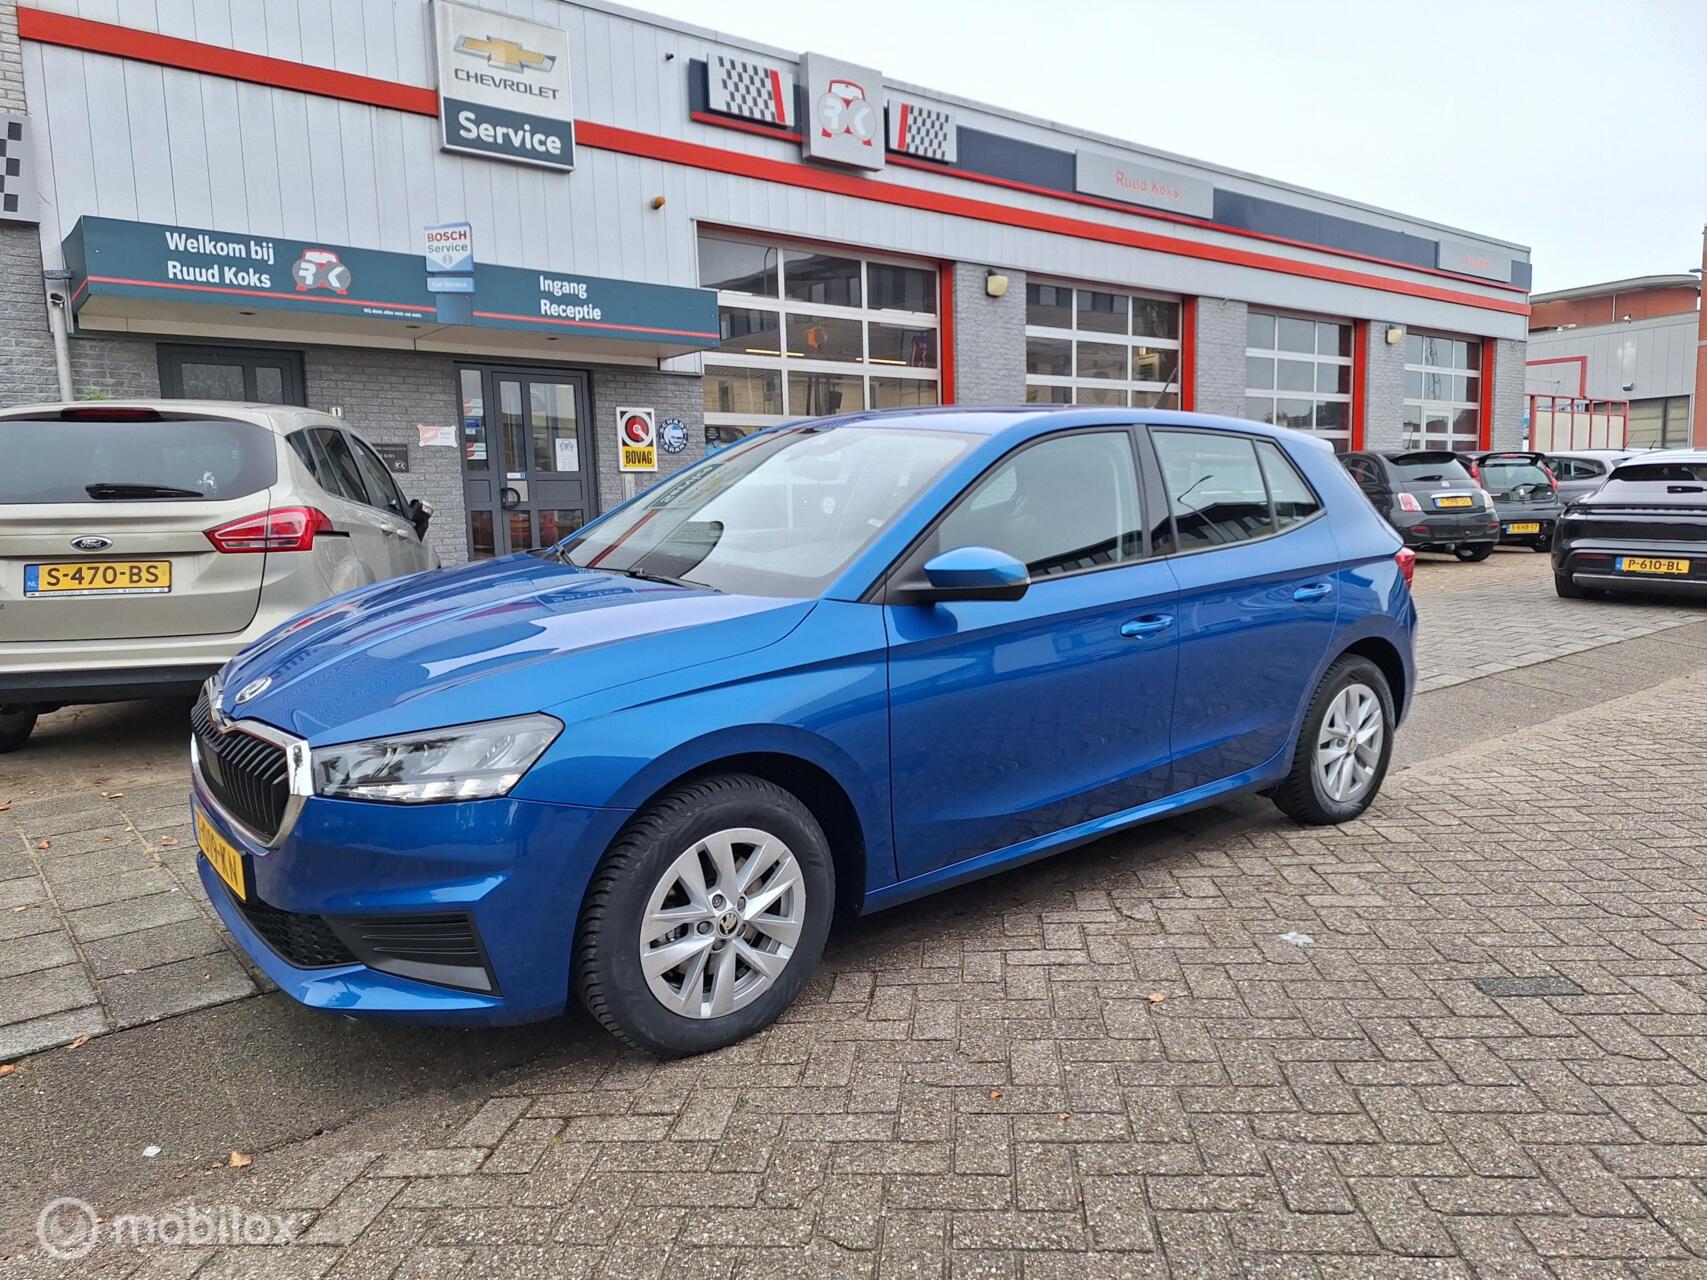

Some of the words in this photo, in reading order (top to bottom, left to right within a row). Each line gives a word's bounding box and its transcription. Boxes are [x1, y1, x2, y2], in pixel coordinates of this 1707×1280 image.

[454, 68, 560, 100] CHEVROLET
[458, 110, 562, 154] Service
[1115, 171, 1148, 192] Ruud
[1151, 180, 1181, 199] Koks
[165, 231, 246, 258] Welkom
[250, 240, 275, 265] bij
[427, 230, 467, 243] BOSCH
[427, 242, 468, 254] Service
[167, 260, 220, 284] Ruud
[224, 266, 272, 289] Koks
[539, 275, 588, 299] Ingang
[540, 299, 602, 321] Receptie
[625, 450, 653, 465] BOVAG
[47, 564, 159, 587] S-470-BS
[1628, 559, 1683, 572] P-610-BL
